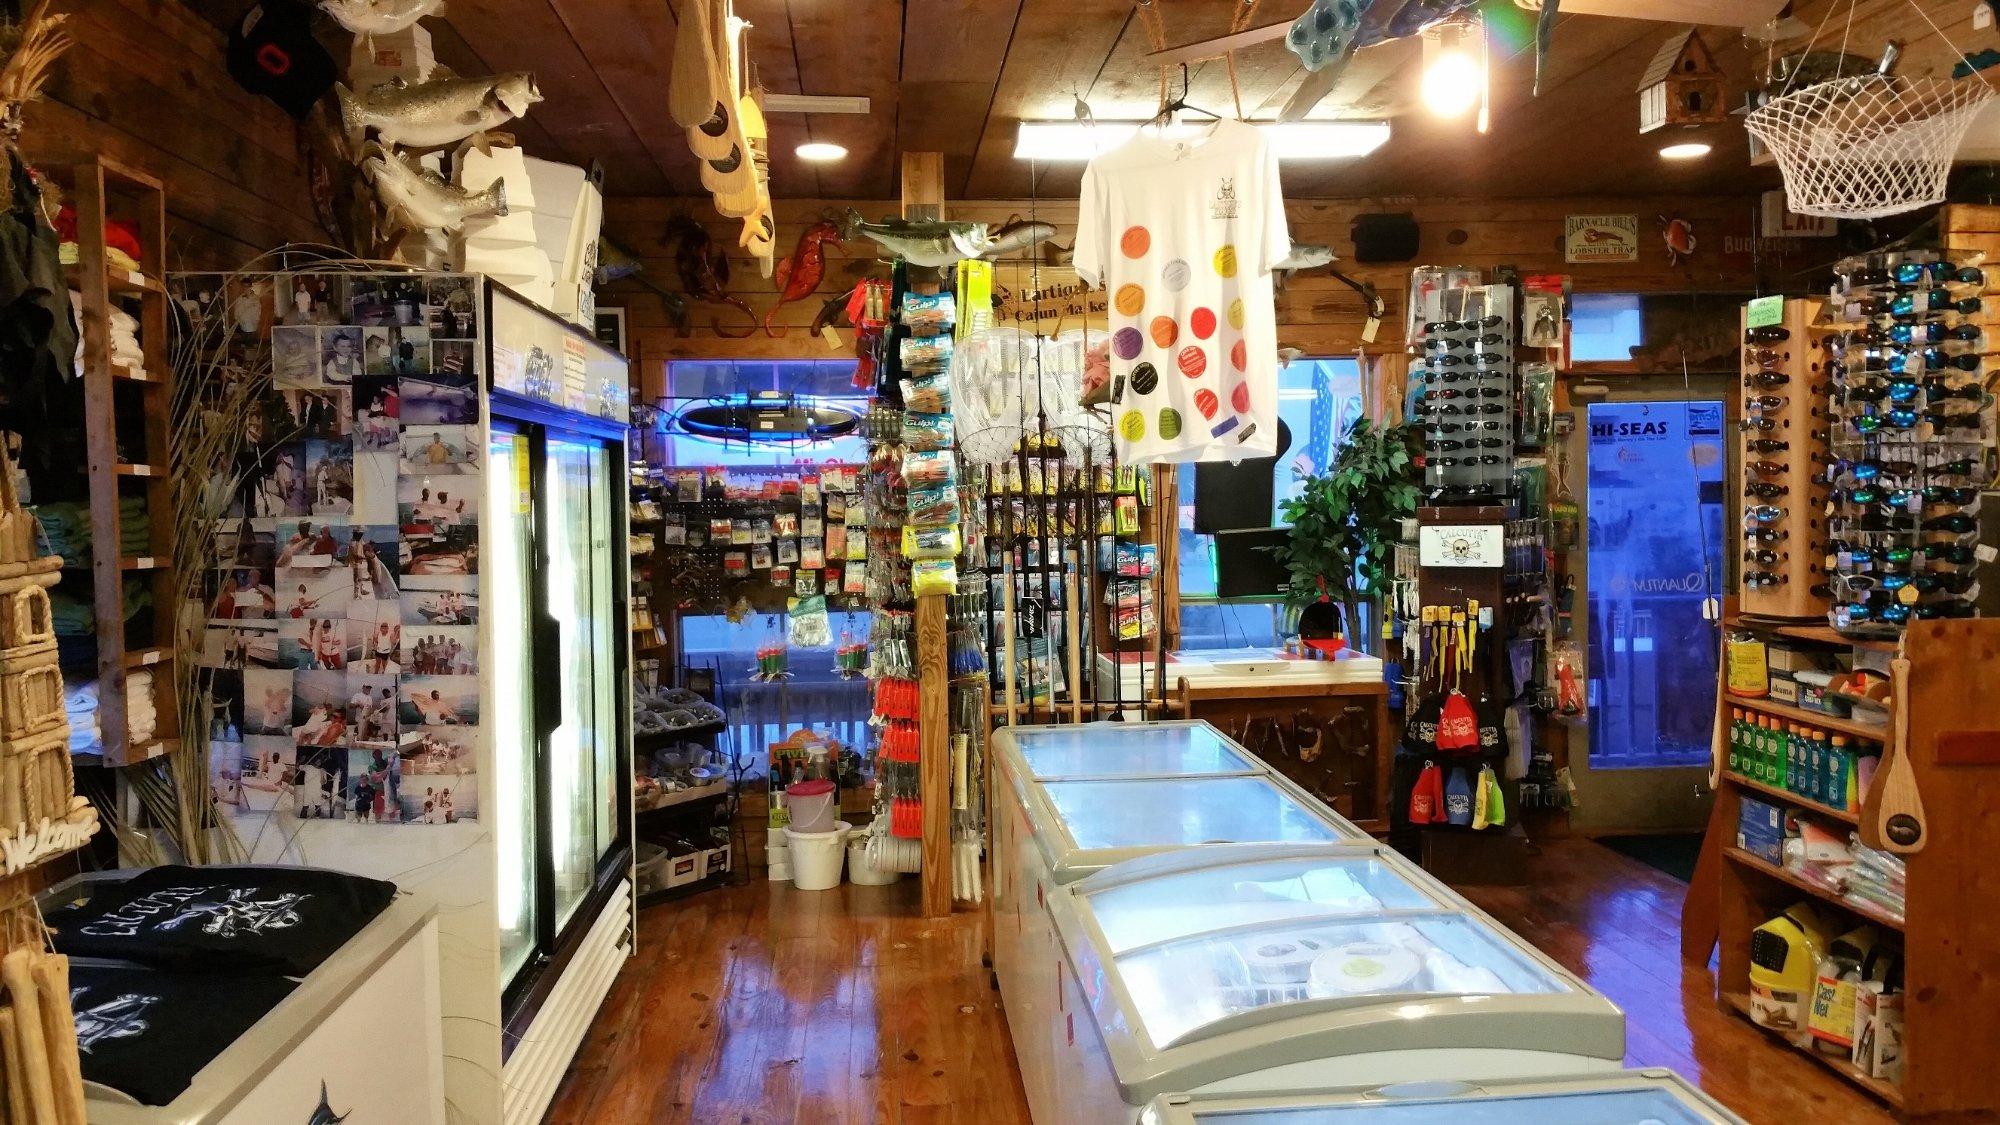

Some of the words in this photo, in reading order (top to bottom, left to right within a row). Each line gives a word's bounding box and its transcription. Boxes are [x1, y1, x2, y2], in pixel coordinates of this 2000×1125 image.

[1569, 247, 1610, 255] LOBSTER
[1612, 245, 1637, 254] TRAP
[1020, 279, 1107, 303] Lartigs
[1060, 299, 1109, 316] Make
[1591, 421, 1668, 437] HI-SEAS
[1440, 528, 1484, 541] CALCUTTA
[1817, 982, 1836, 1001] Cast
[1813, 1000, 1830, 1018] Net
